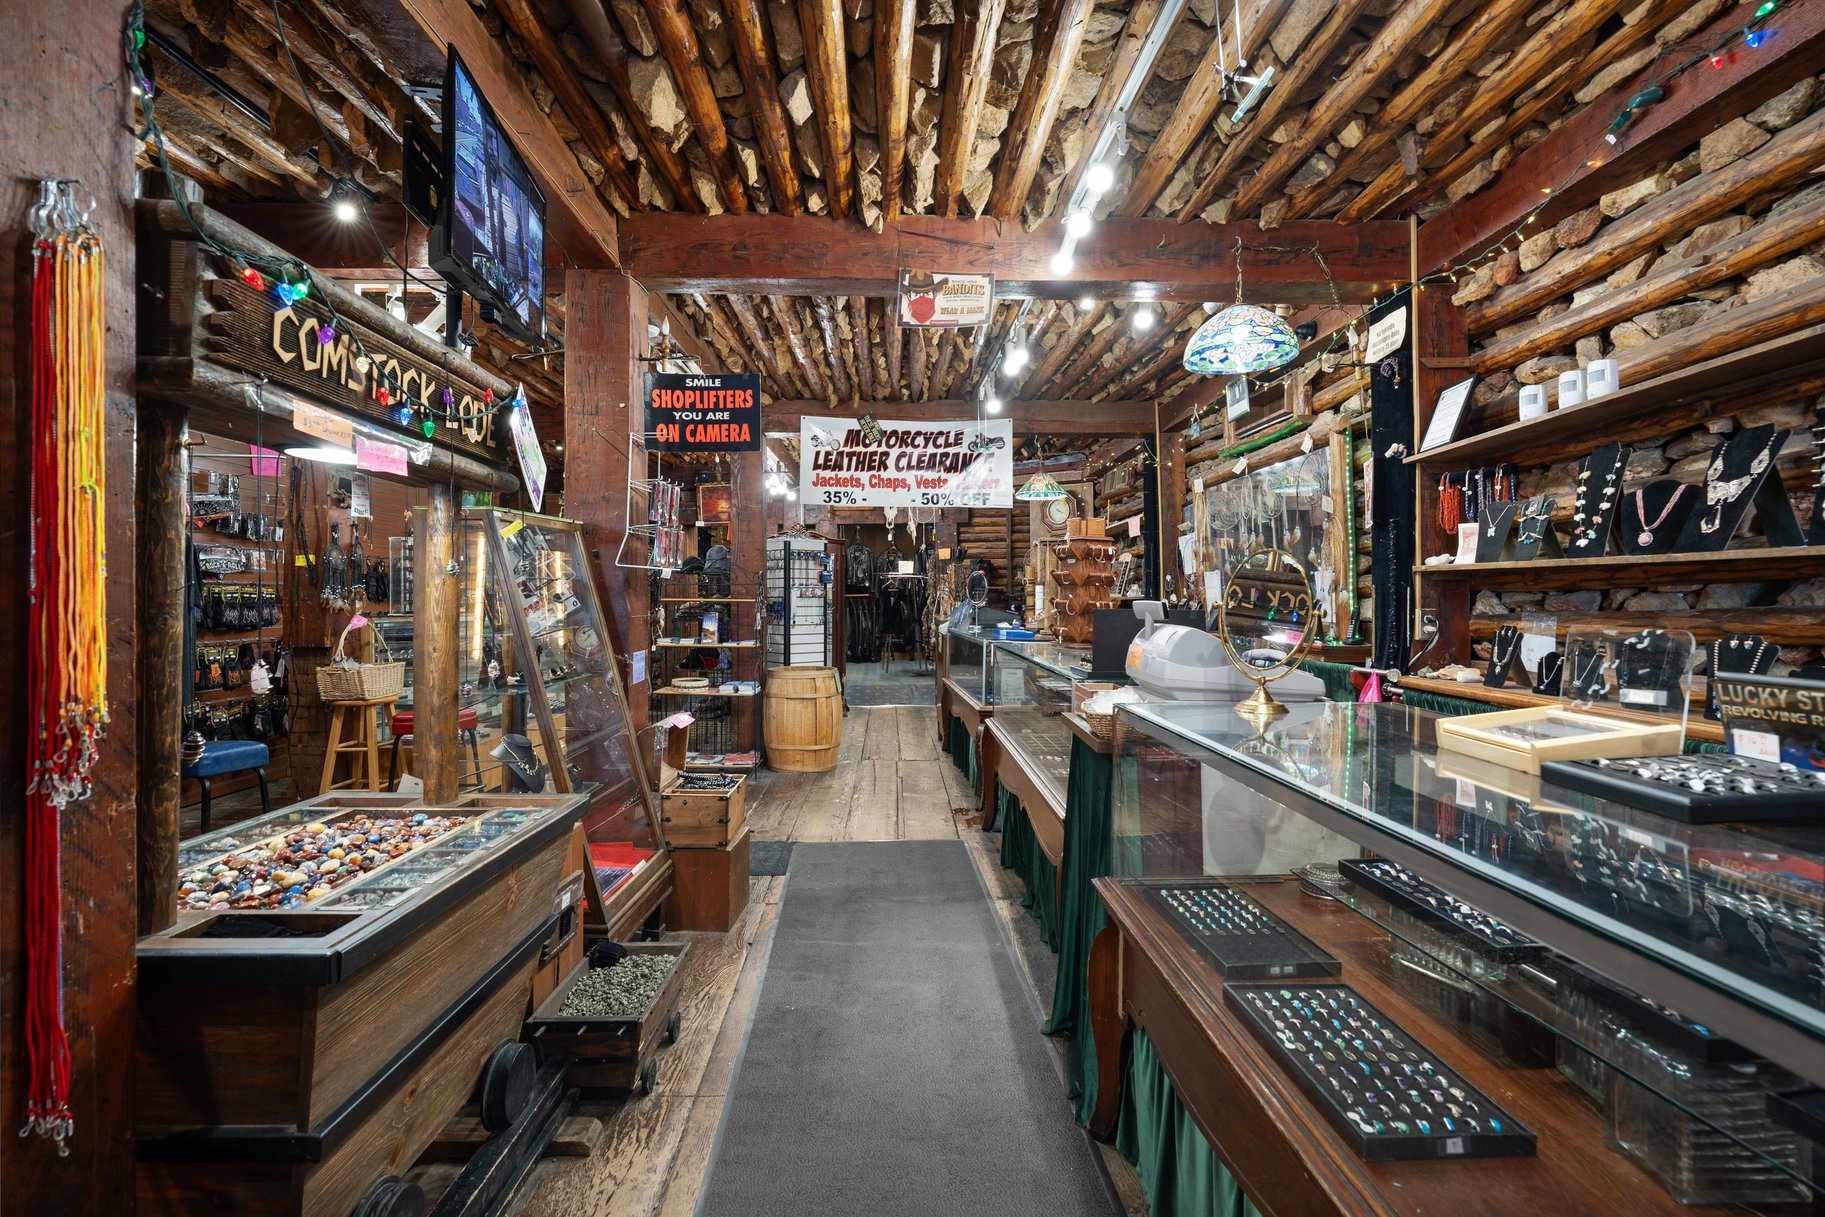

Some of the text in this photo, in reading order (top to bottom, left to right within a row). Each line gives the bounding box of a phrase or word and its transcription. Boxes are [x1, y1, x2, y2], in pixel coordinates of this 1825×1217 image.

[942, 284, 985, 295] BANDITS
[273, 306, 499, 448] COMSTOCK LODE
[685, 378, 722, 387] SMILE
[651, 388, 754, 409] SHOPLIFTERS
[673, 411, 730, 420] YOU ARE
[656, 423, 751, 443] ON CAMERA
[812, 450, 890, 473] LEATHER
[812, 473, 866, 491] Jackets,
[868, 473, 911, 492] Chaps,
[823, 490, 857, 505] 35%
[921, 492, 955, 506] 50%
[960, 492, 992, 506] OFF
[1717, 683, 1788, 708] LUCKY
[1721, 704, 1825, 727] REVOLVING R
